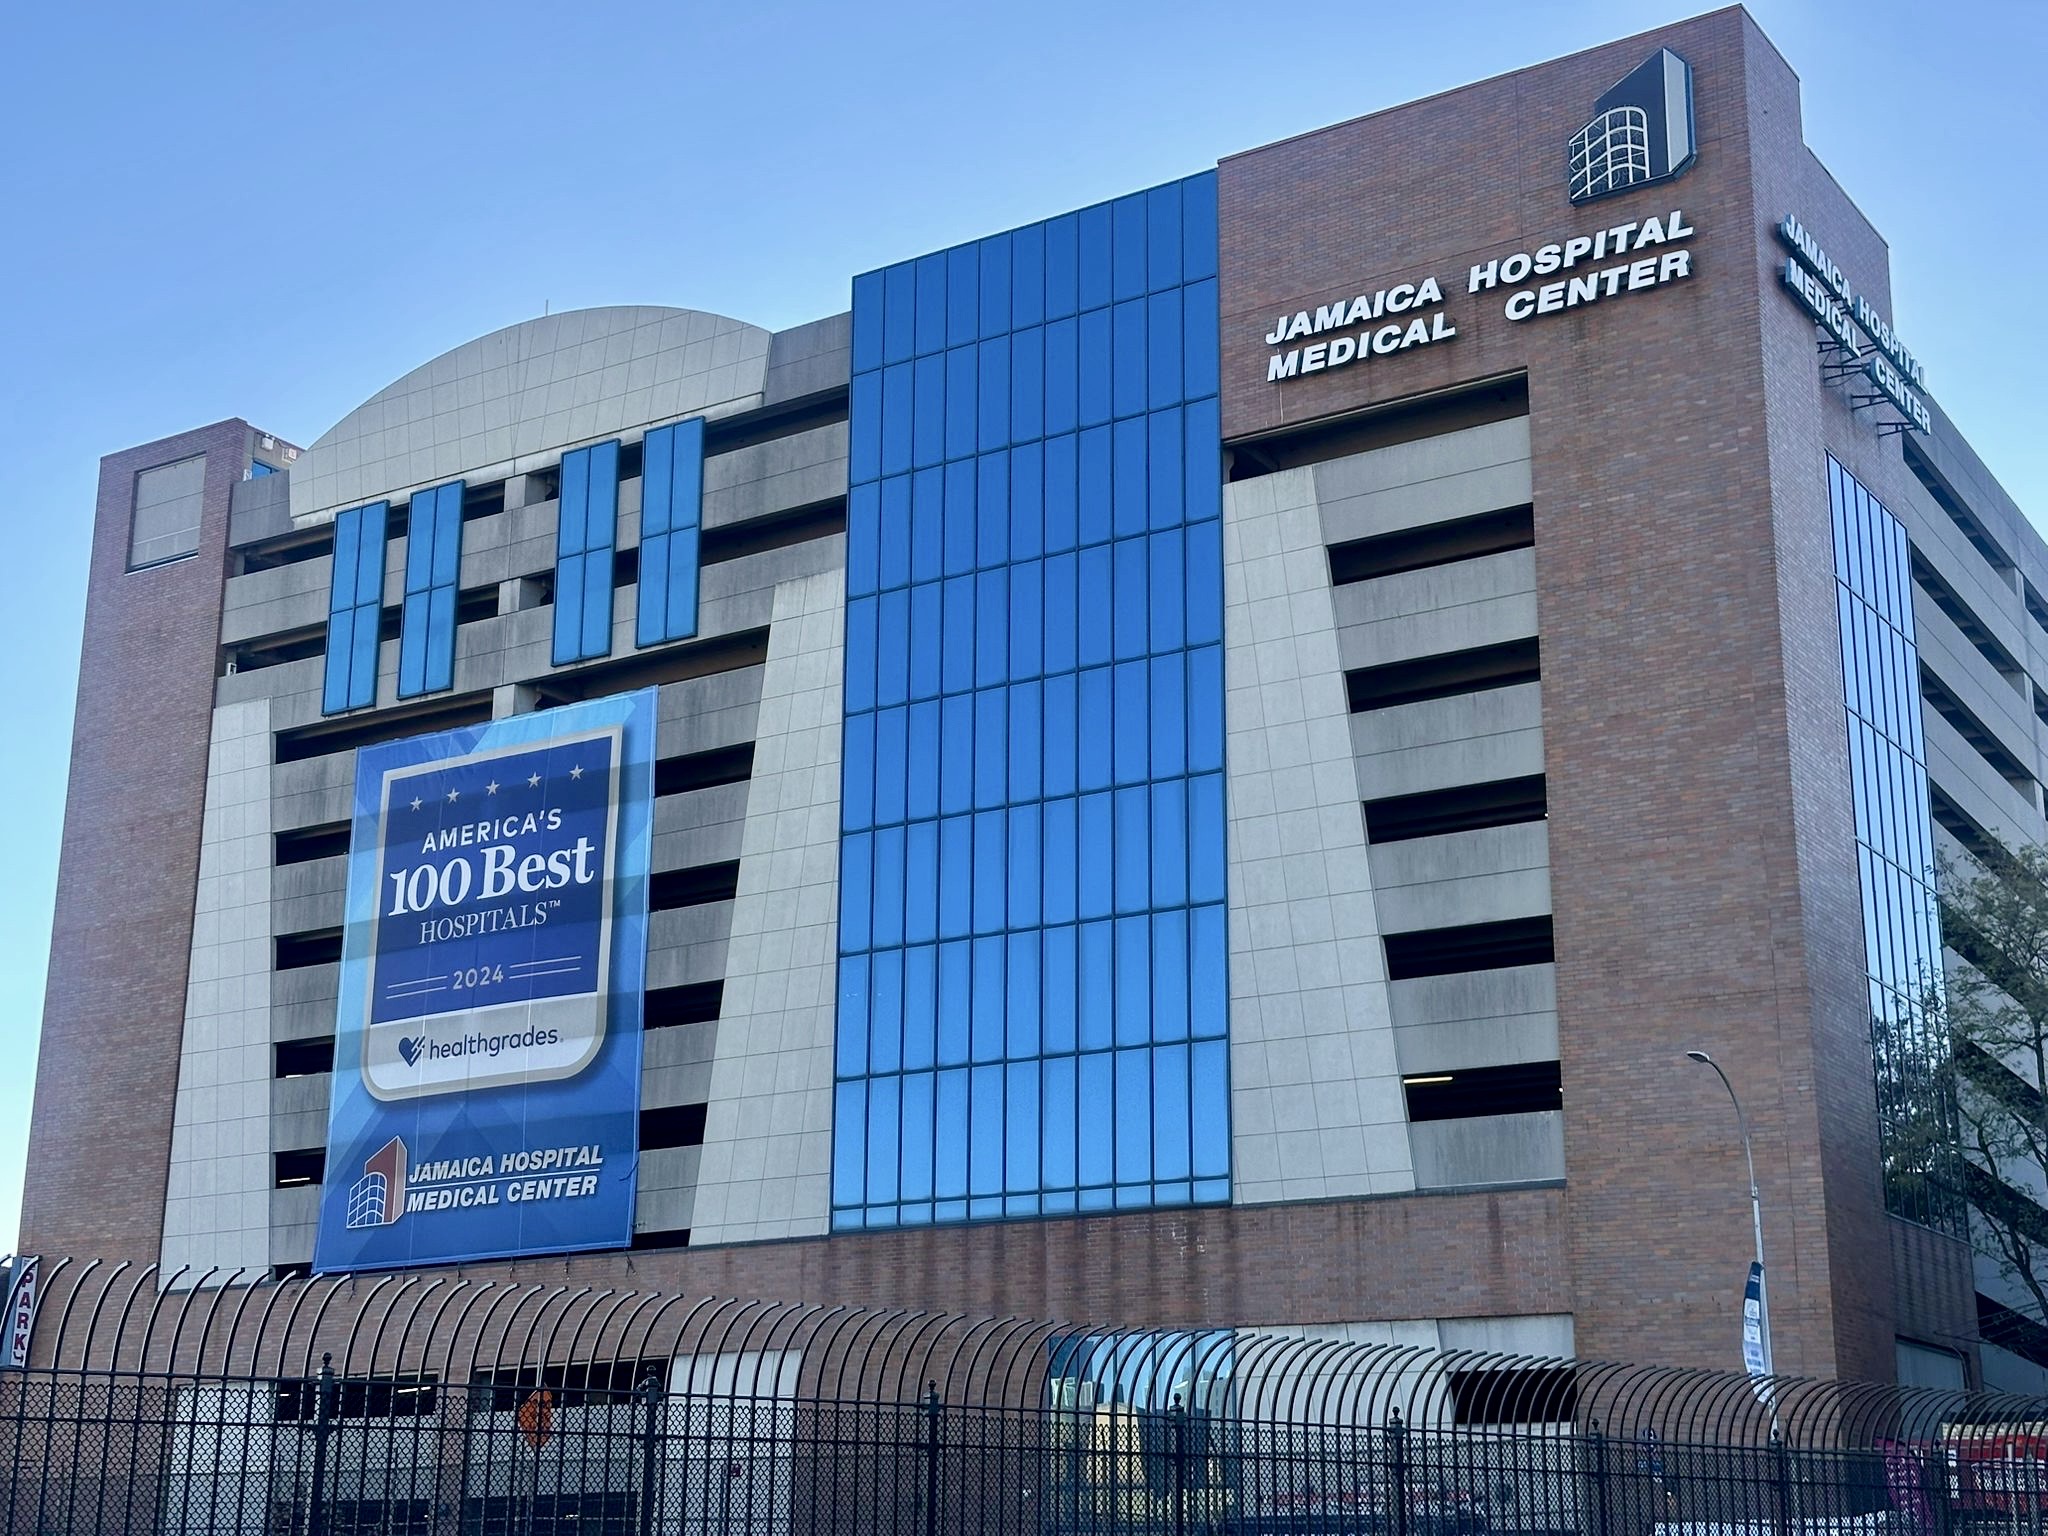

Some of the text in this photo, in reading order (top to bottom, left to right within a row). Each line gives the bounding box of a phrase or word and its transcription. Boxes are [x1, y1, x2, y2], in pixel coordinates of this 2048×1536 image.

[1265, 209, 1695, 345] JAMAICA HOSPITAL
[1785, 213, 1928, 395] JAMAICA HOSPITAL
[1267, 249, 1692, 382] MEDICAL CENTER
[1789, 257, 1931, 435] MEDICAL CENTER
[421, 808, 562, 854] AMERICA'S
[388, 836, 596, 917] 100 Best
[452, 963, 504, 990] 2024
[429, 1025, 558, 1060] healthgrades
[406, 1175, 598, 1212] MEDICAL CENTER
[409, 1145, 603, 1184] JAMAICA HOSPITAL
